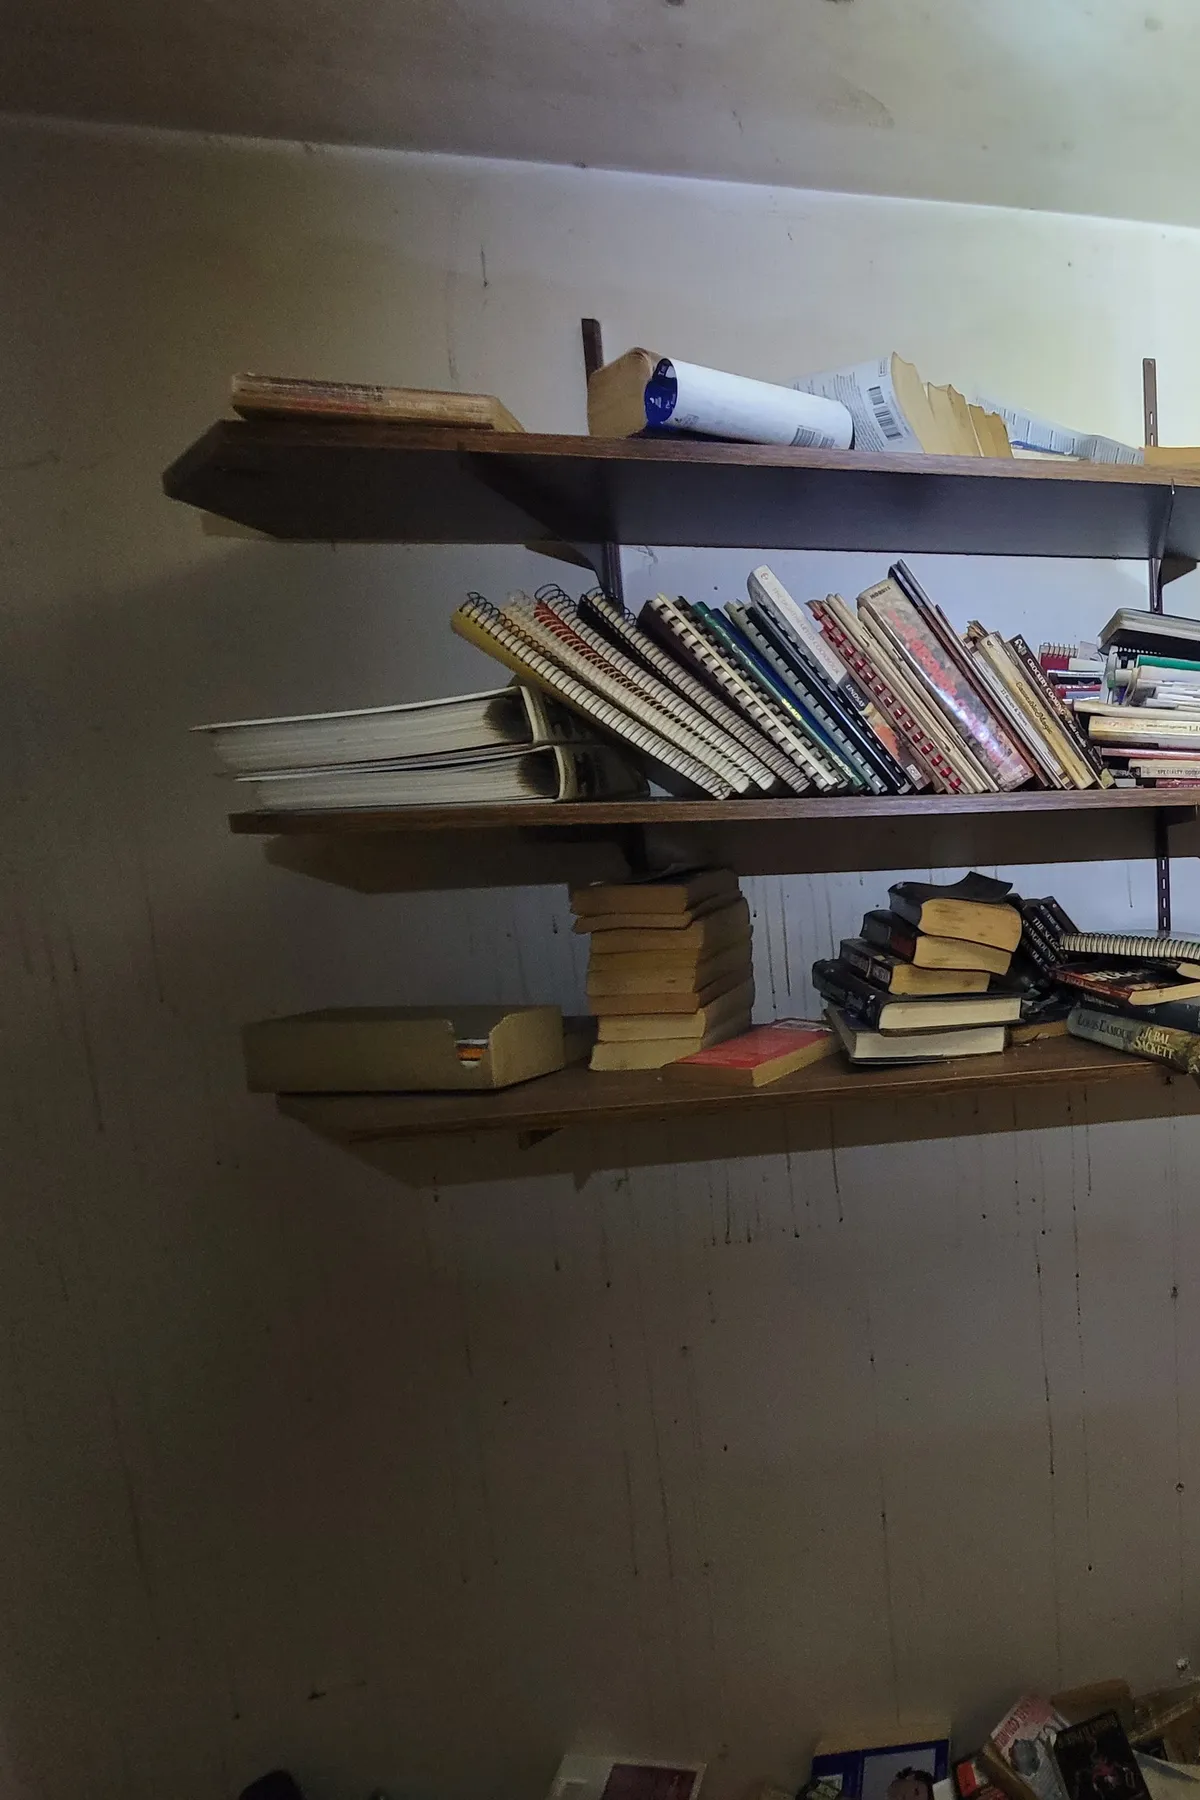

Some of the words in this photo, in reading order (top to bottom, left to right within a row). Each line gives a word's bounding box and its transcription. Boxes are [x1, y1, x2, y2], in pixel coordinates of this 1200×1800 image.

[843, 683, 867, 707] LINDSAY
[1024, 658, 1050, 687] CROCKERY
[1042, 687, 1067, 714] COOKING
[1031, 916, 1045, 931] THE
[1141, 1027, 1172, 1046] JUBAL
[1133, 1038, 1175, 1060] SACKETT
